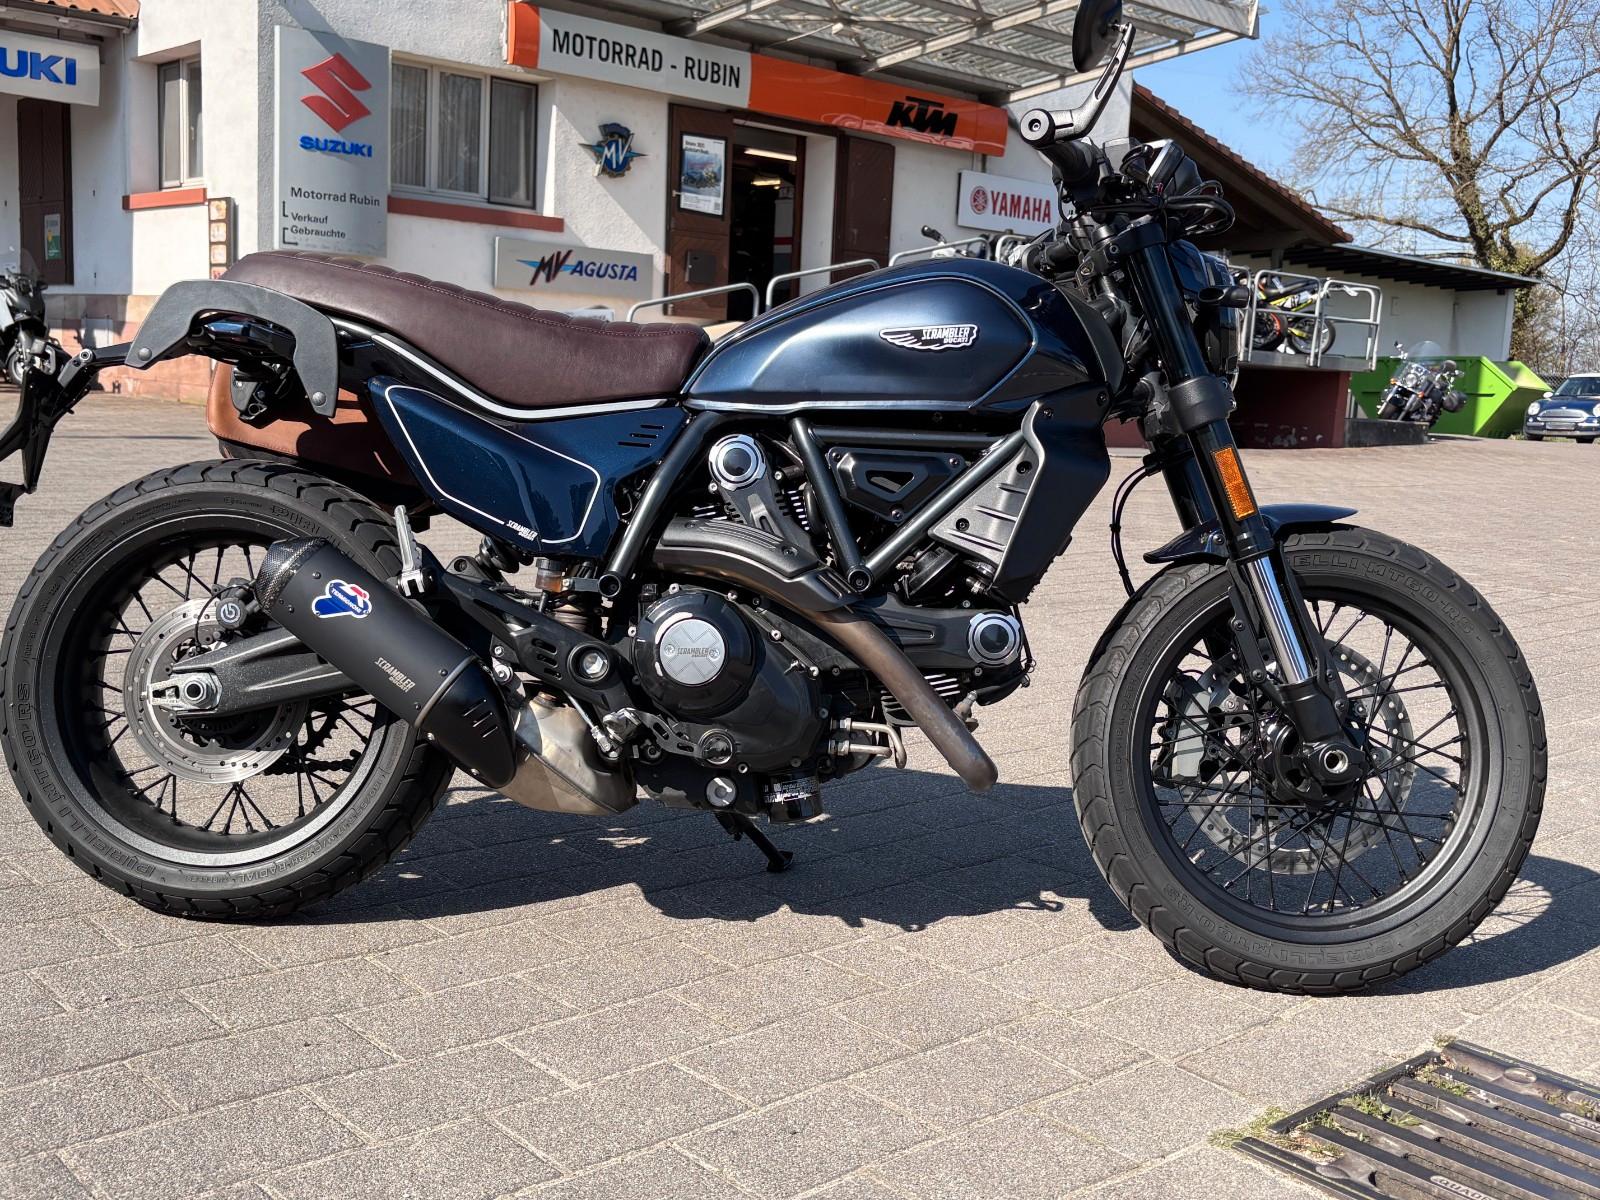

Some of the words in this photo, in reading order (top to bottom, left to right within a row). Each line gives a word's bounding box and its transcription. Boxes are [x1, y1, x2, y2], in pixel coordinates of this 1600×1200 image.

[552, 28, 664, 73] MOTORRAD
[684, 55, 741, 89] RUBIN
[885, 95, 958, 137] KTM
[299, 136, 373, 158] SUZUKI
[598, 133, 635, 176] MV
[290, 186, 347, 203] Motorrad
[350, 193, 381, 207] Rubin
[990, 190, 1052, 224] YAMAHA
[290, 211, 329, 225] Verkauf
[290, 224, 347, 239] Gebrauchte
[529, 249, 574, 286] MV
[569, 260, 638, 282] AGUSTA
[921, 327, 971, 341] SCRAMBLER
[1286, 553, 1360, 569] ELLI
[374, 657, 416, 689] SCRAMBLER
[58, 806, 157, 878] PIRELLI
